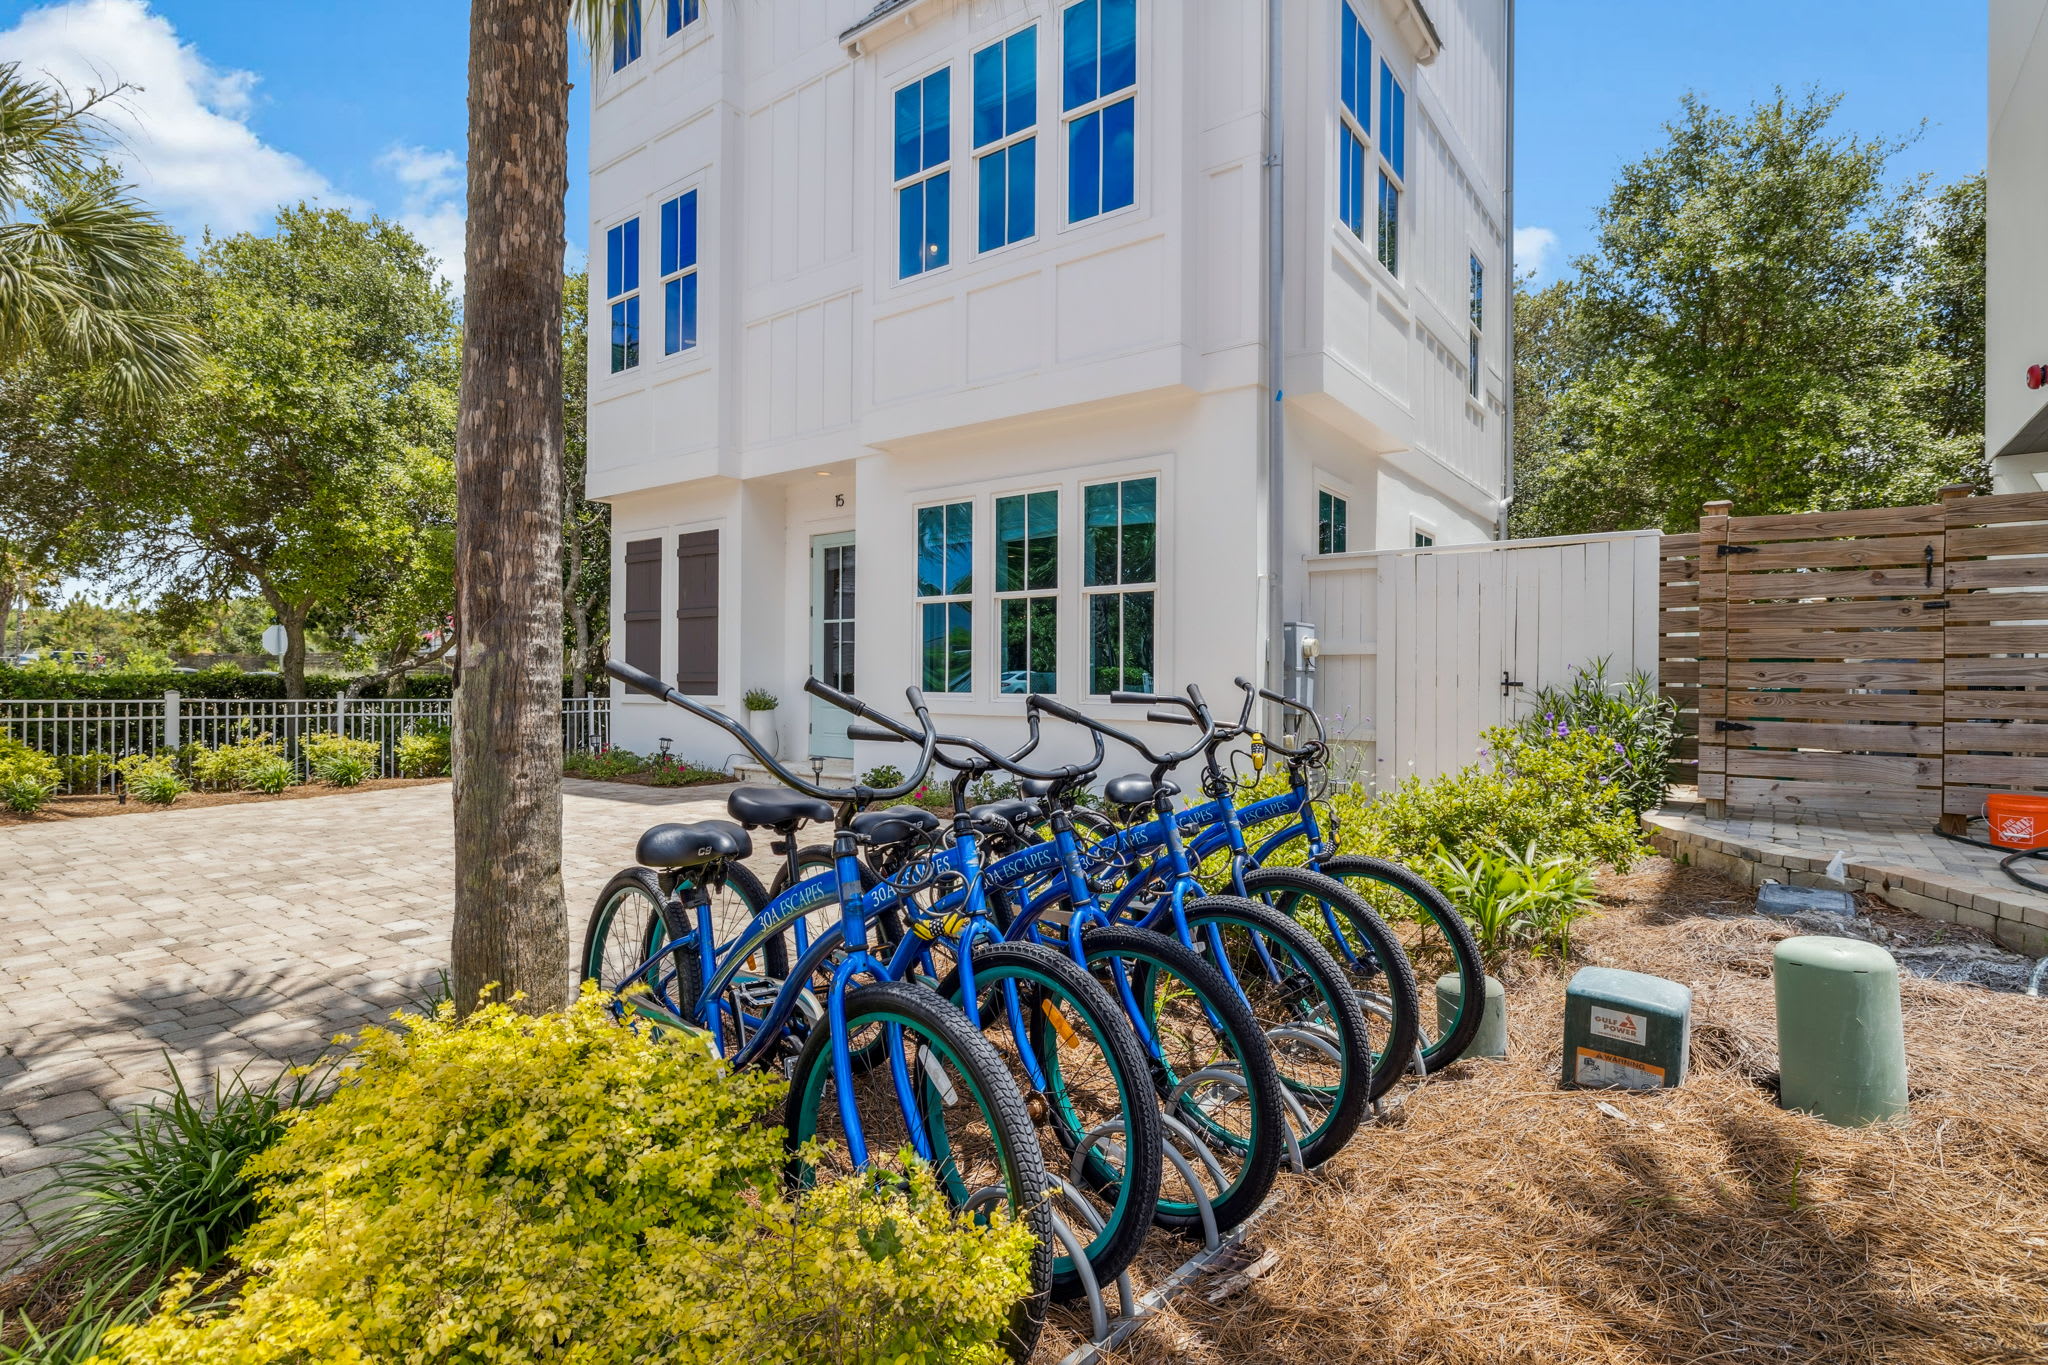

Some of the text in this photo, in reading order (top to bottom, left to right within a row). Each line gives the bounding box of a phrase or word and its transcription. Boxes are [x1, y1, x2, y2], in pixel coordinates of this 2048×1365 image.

[835, 493, 845, 508] 15
[1244, 800, 1290, 823] ESCAPES
[1002, 849, 1052, 878] ESCAPES
[871, 884, 898, 908] 30A
[758, 881, 825, 933] 30A ESCAPES
[1594, 1015, 1618, 1026] GULF
[1603, 1023, 1637, 1037] POWER
[1604, 1054, 1646, 1071] WARNING
